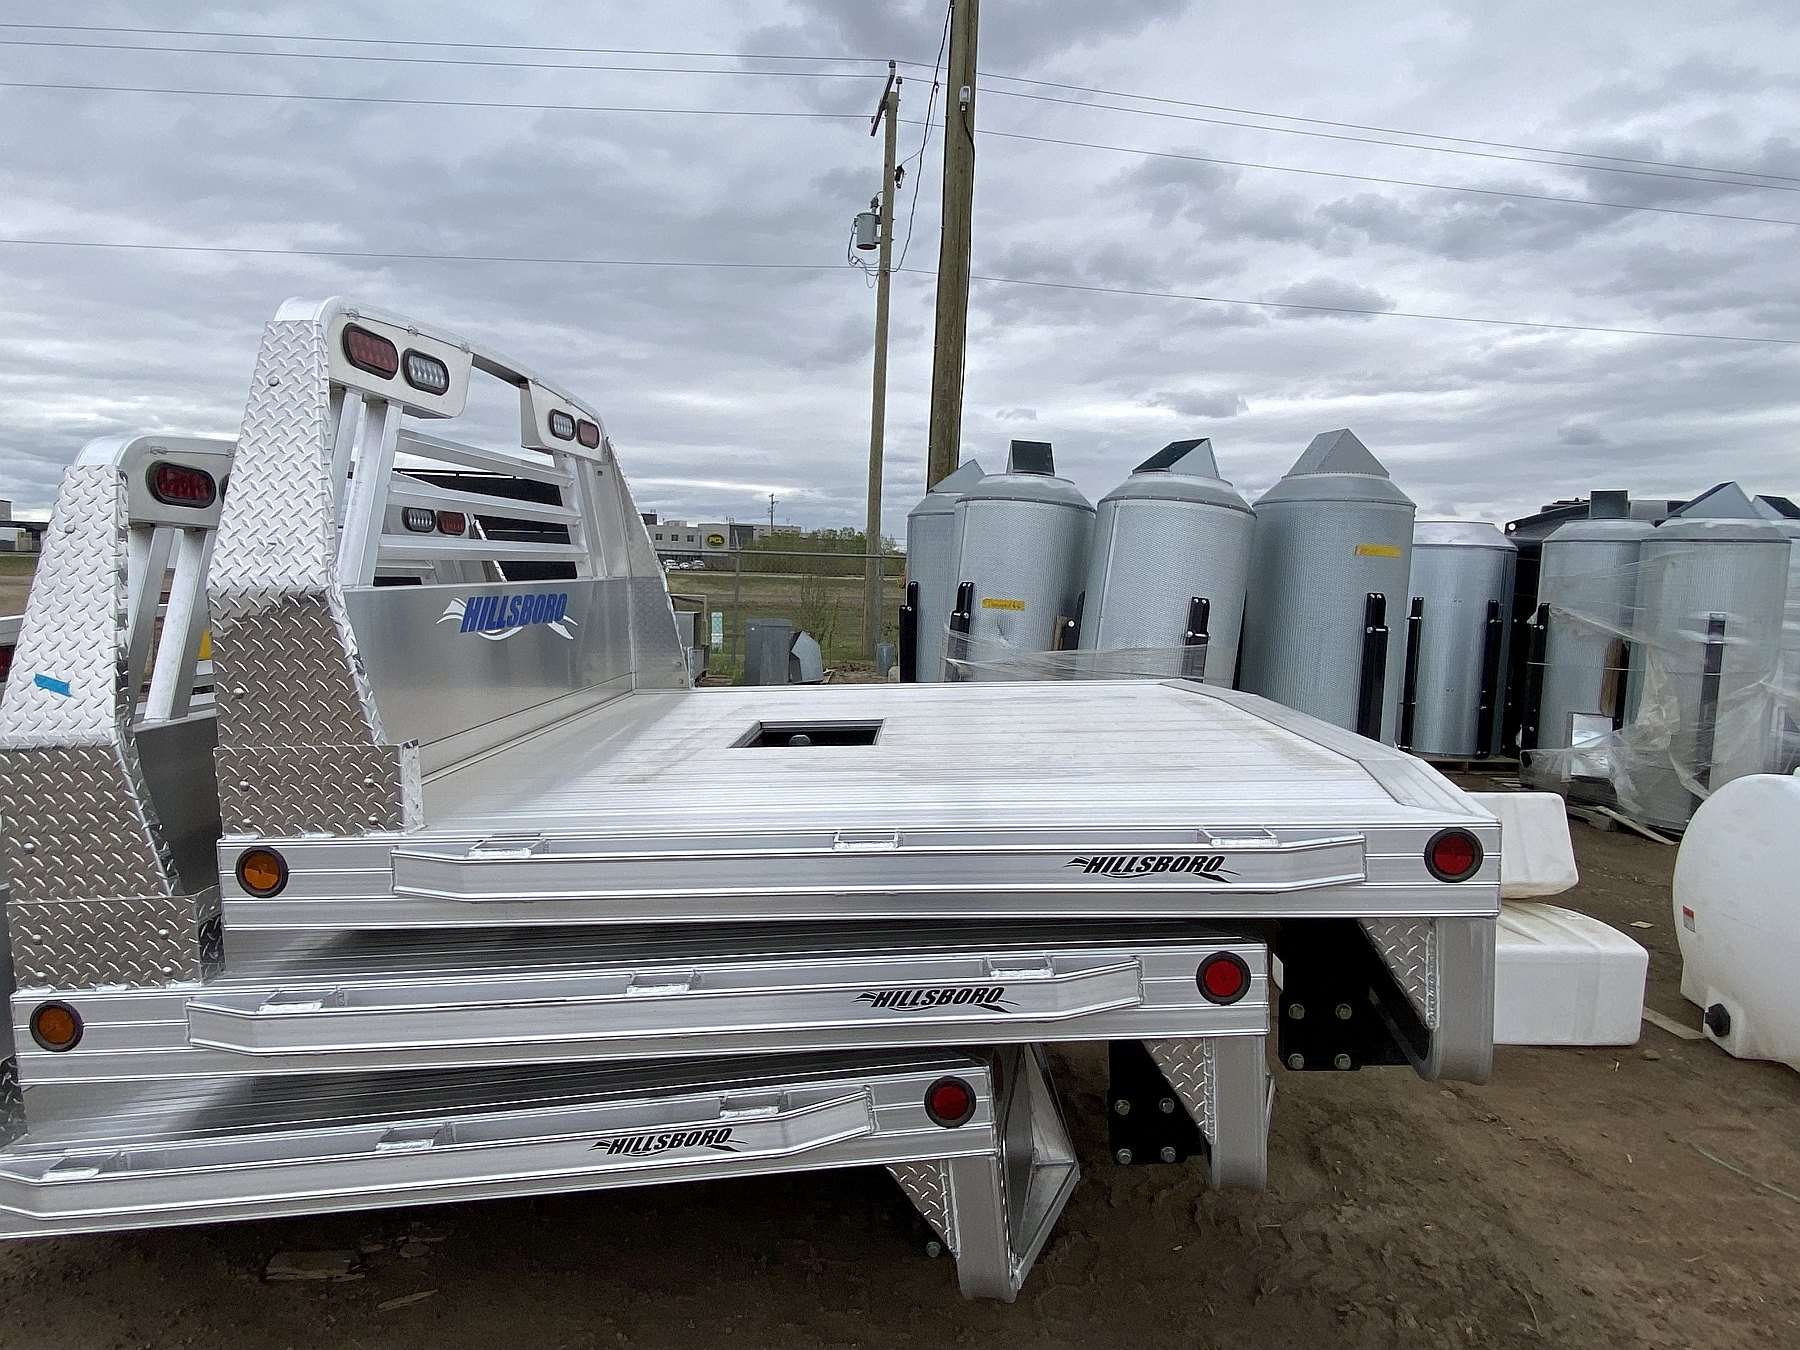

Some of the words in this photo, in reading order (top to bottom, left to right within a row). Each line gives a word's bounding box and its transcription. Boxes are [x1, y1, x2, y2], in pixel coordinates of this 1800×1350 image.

[460, 593, 568, 633] HILLSBORO
[1083, 855, 1226, 874] HILLSBORO
[871, 986, 1006, 1008] HILLSBORO
[606, 1127, 734, 1156] HILLSBORO
